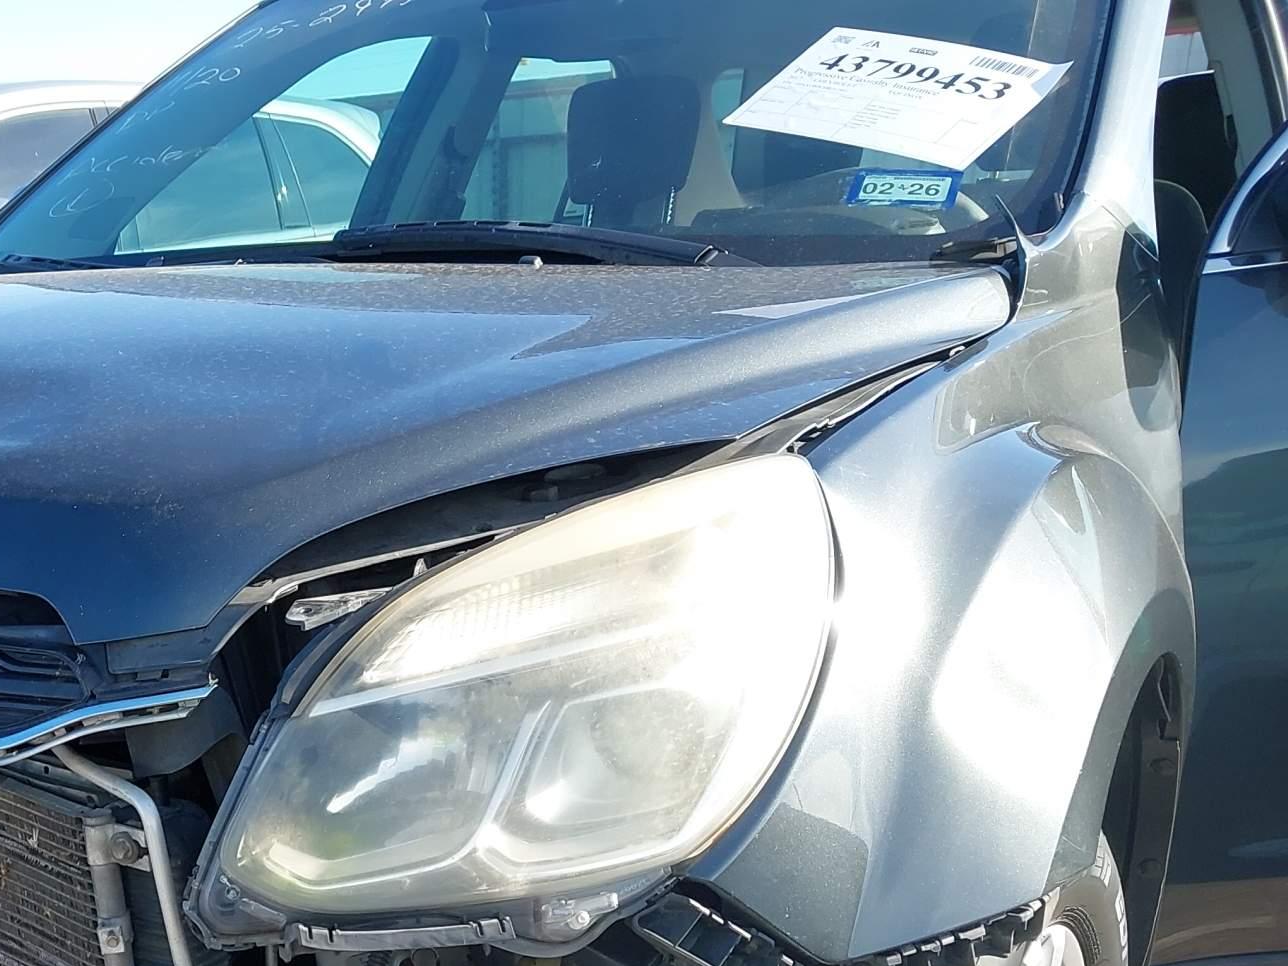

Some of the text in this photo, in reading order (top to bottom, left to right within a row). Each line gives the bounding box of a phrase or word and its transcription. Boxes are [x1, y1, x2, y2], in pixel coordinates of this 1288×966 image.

[819, 53, 1012, 100] 43799453
[862, 182, 941, 196] 02 26
